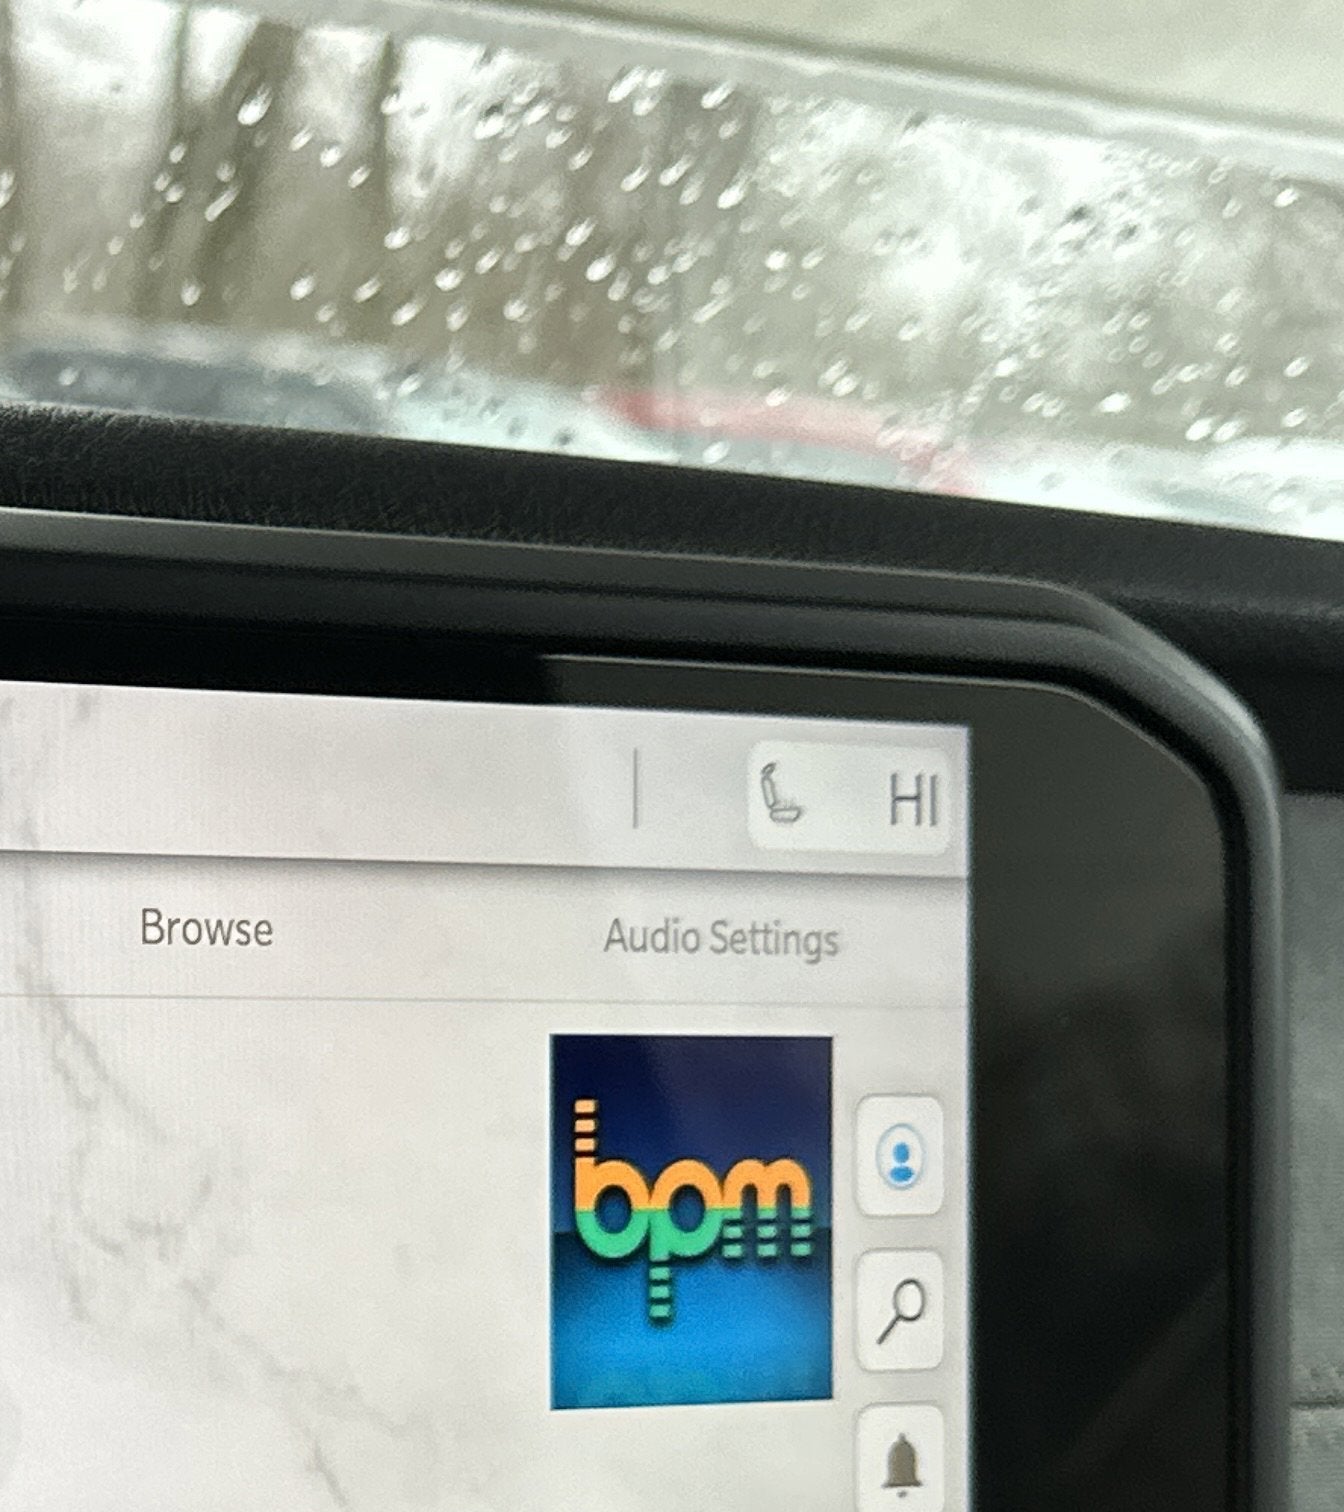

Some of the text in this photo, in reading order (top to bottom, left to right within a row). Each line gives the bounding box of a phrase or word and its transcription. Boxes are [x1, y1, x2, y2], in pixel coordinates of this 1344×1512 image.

[890, 772, 938, 827] HI
[141, 907, 273, 947] Browse
[603, 917, 840, 964] Audio Settings
[575, 1100, 811, 1318] bpm
